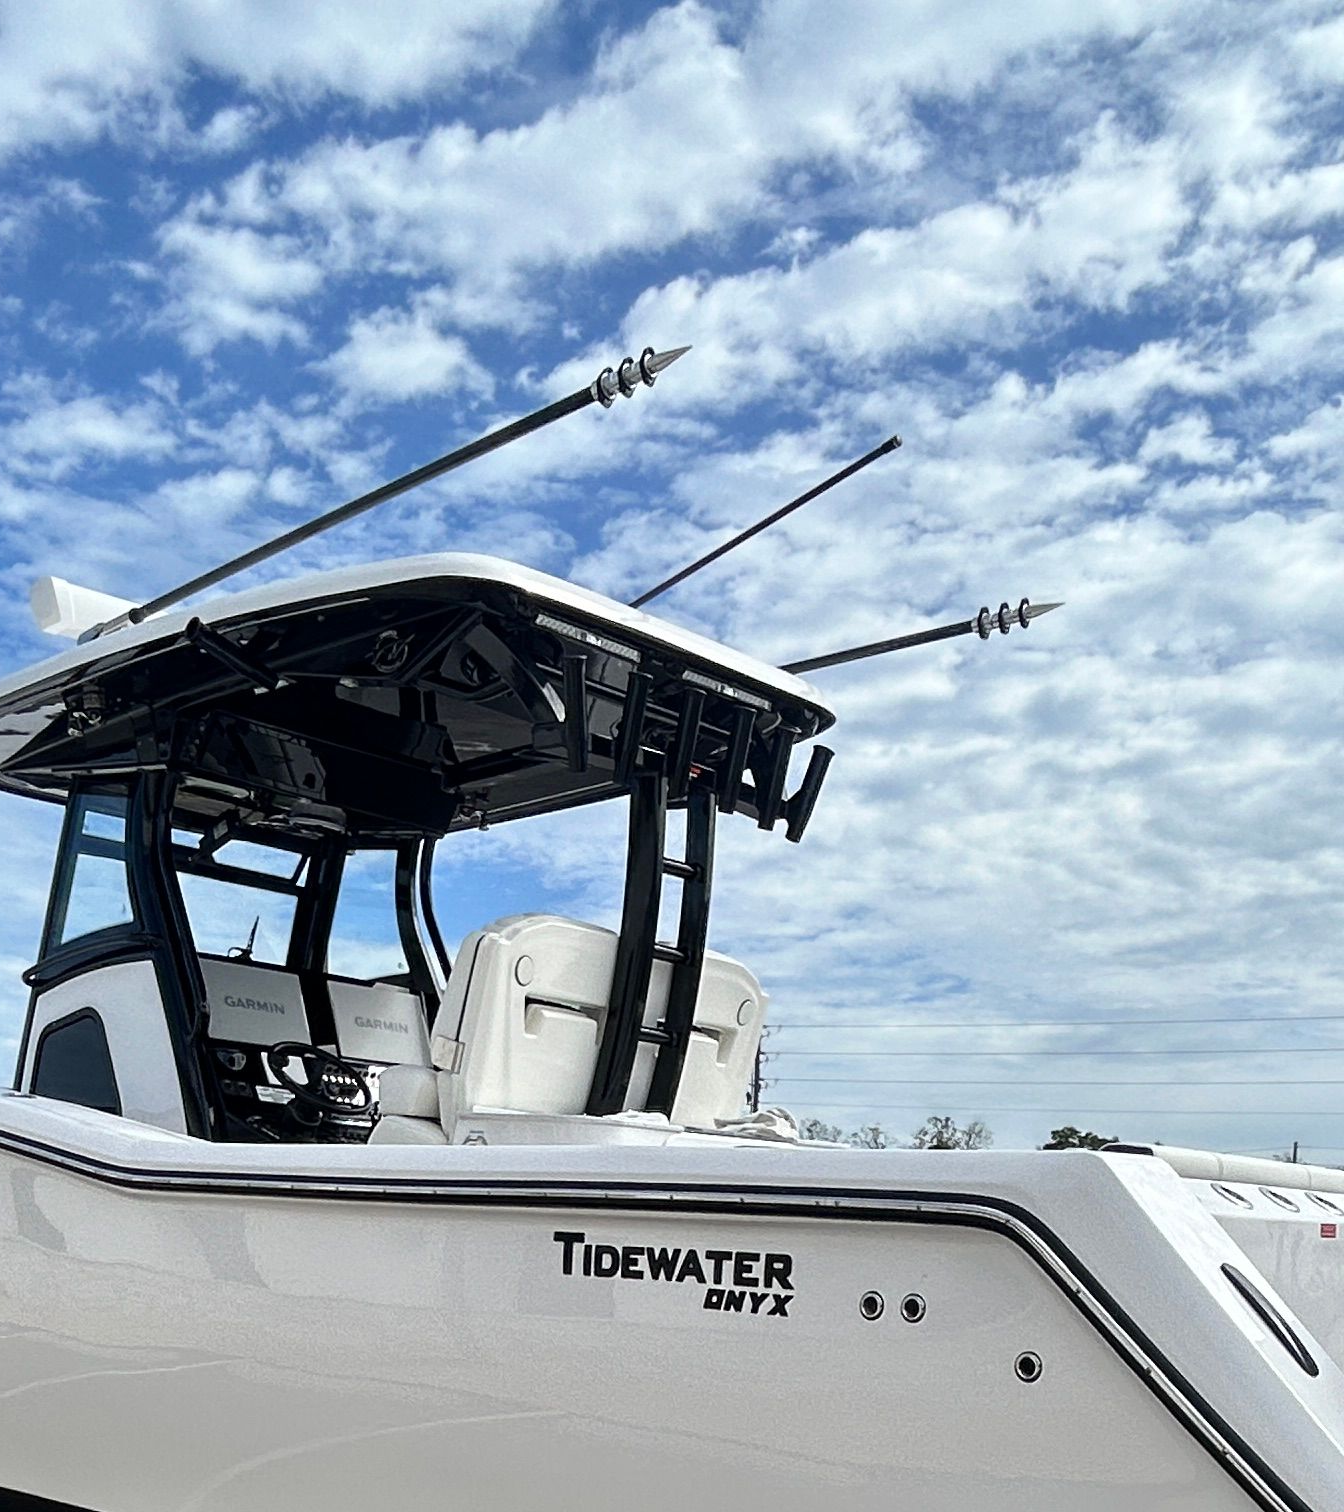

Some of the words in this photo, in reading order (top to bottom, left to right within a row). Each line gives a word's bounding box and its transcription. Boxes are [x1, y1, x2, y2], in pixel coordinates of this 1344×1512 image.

[224, 995, 285, 1015] GARMIN
[354, 1016, 409, 1034] GARMIN
[553, 1231, 794, 1291] TIDEWATER
[703, 1288, 794, 1317] ONYX
